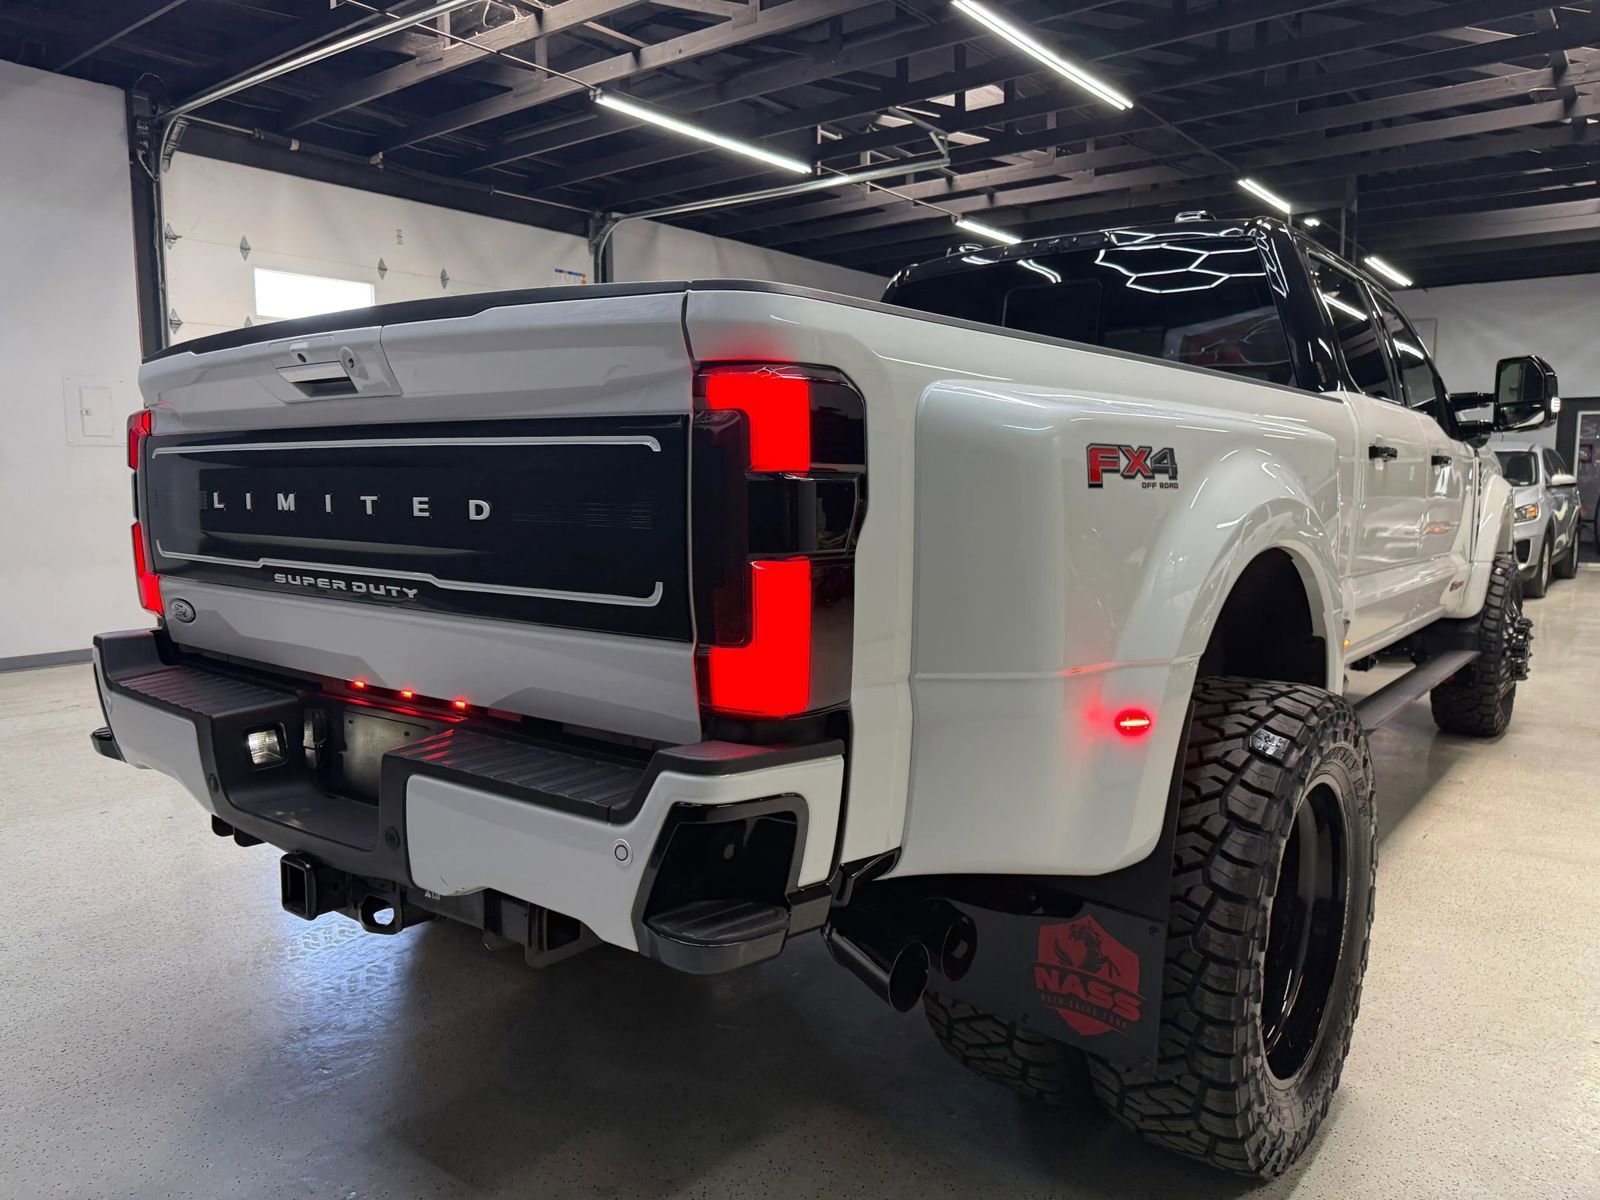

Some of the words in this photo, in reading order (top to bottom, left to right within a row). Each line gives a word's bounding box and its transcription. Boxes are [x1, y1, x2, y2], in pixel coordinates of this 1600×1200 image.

[1086, 443, 1178, 488] FX4
[213, 492, 491, 521] LIMITED
[274, 574, 347, 591] SUPER
[351, 582, 419, 599] DUTY
[1034, 966, 1141, 1022] NASS
